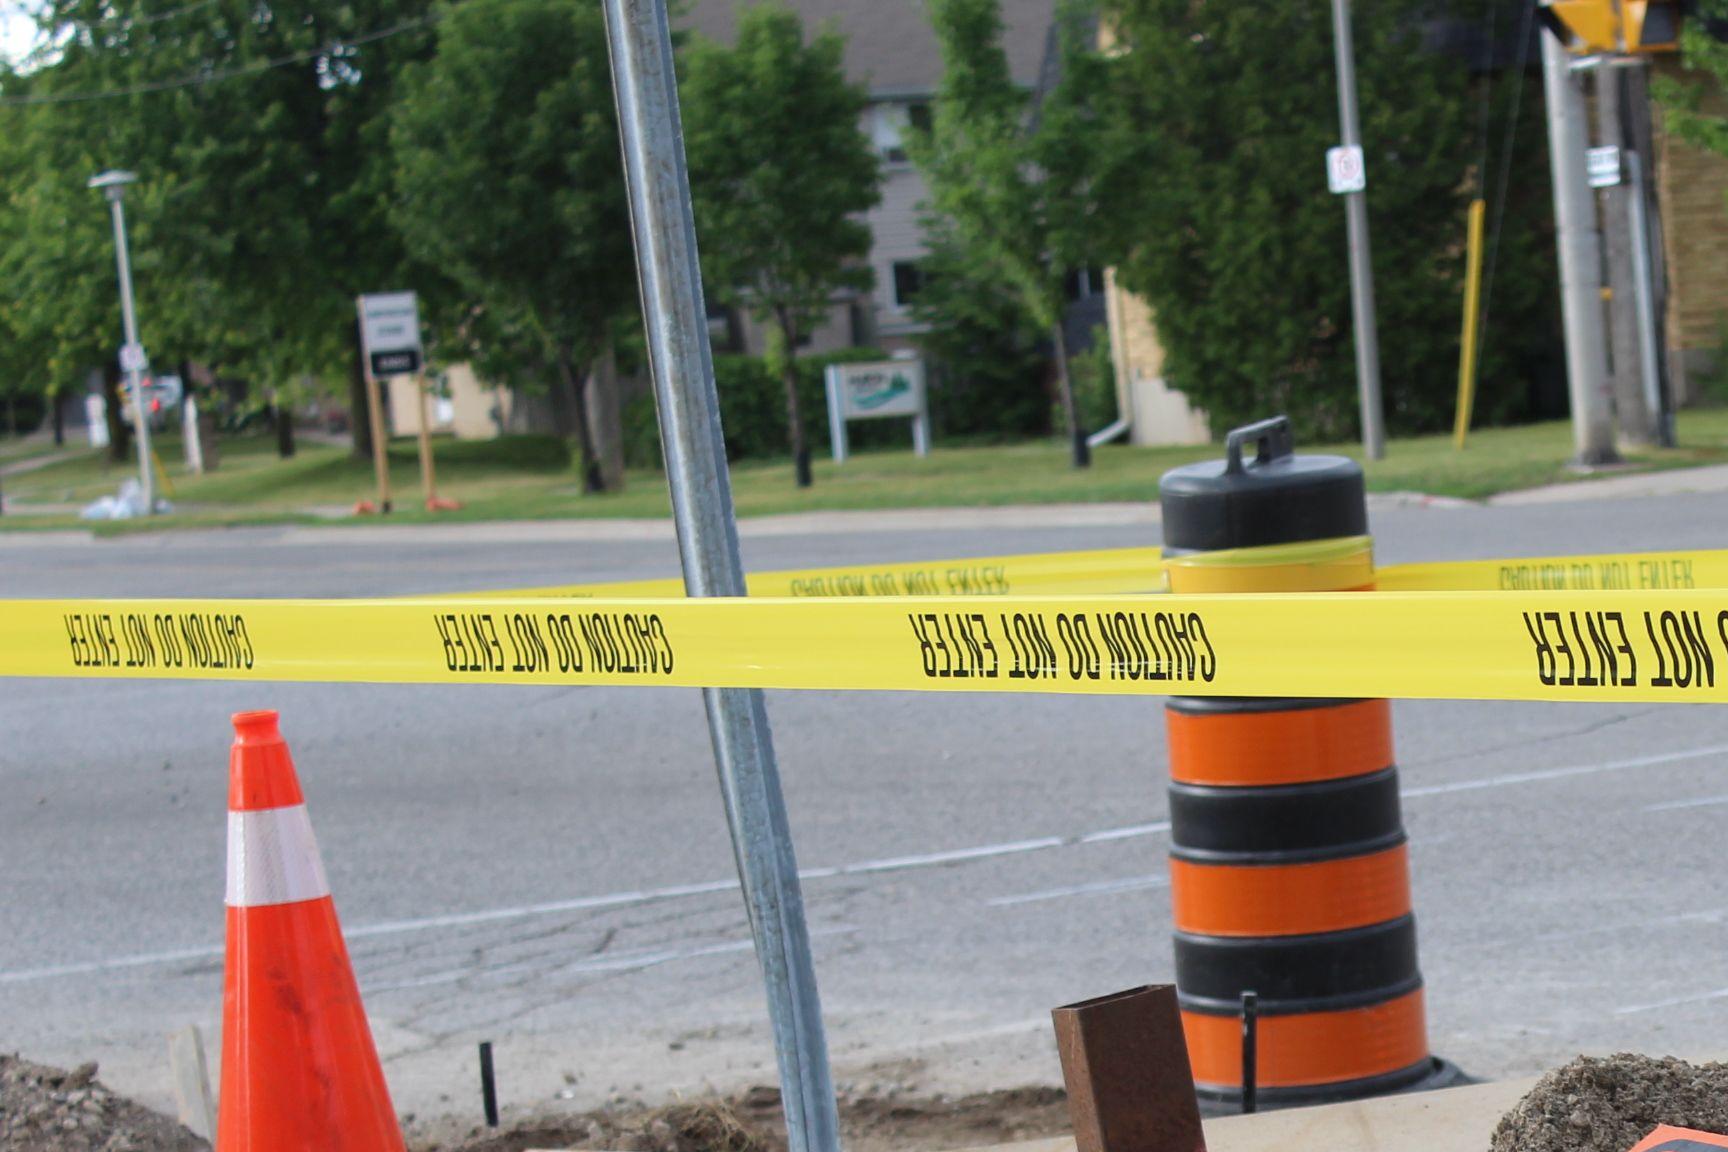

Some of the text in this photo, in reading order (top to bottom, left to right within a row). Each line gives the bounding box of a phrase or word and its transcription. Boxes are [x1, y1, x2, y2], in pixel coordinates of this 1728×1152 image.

[63, 613, 254, 670] CAUTION DO NOT ENTER
[434, 613, 674, 675] CAUTION DO NOT ENTER
[908, 611, 1217, 683] CAUTION DO NOT ENTER
[1522, 611, 1637, 687] ENTER
[1643, 610, 1715, 689] NOT
